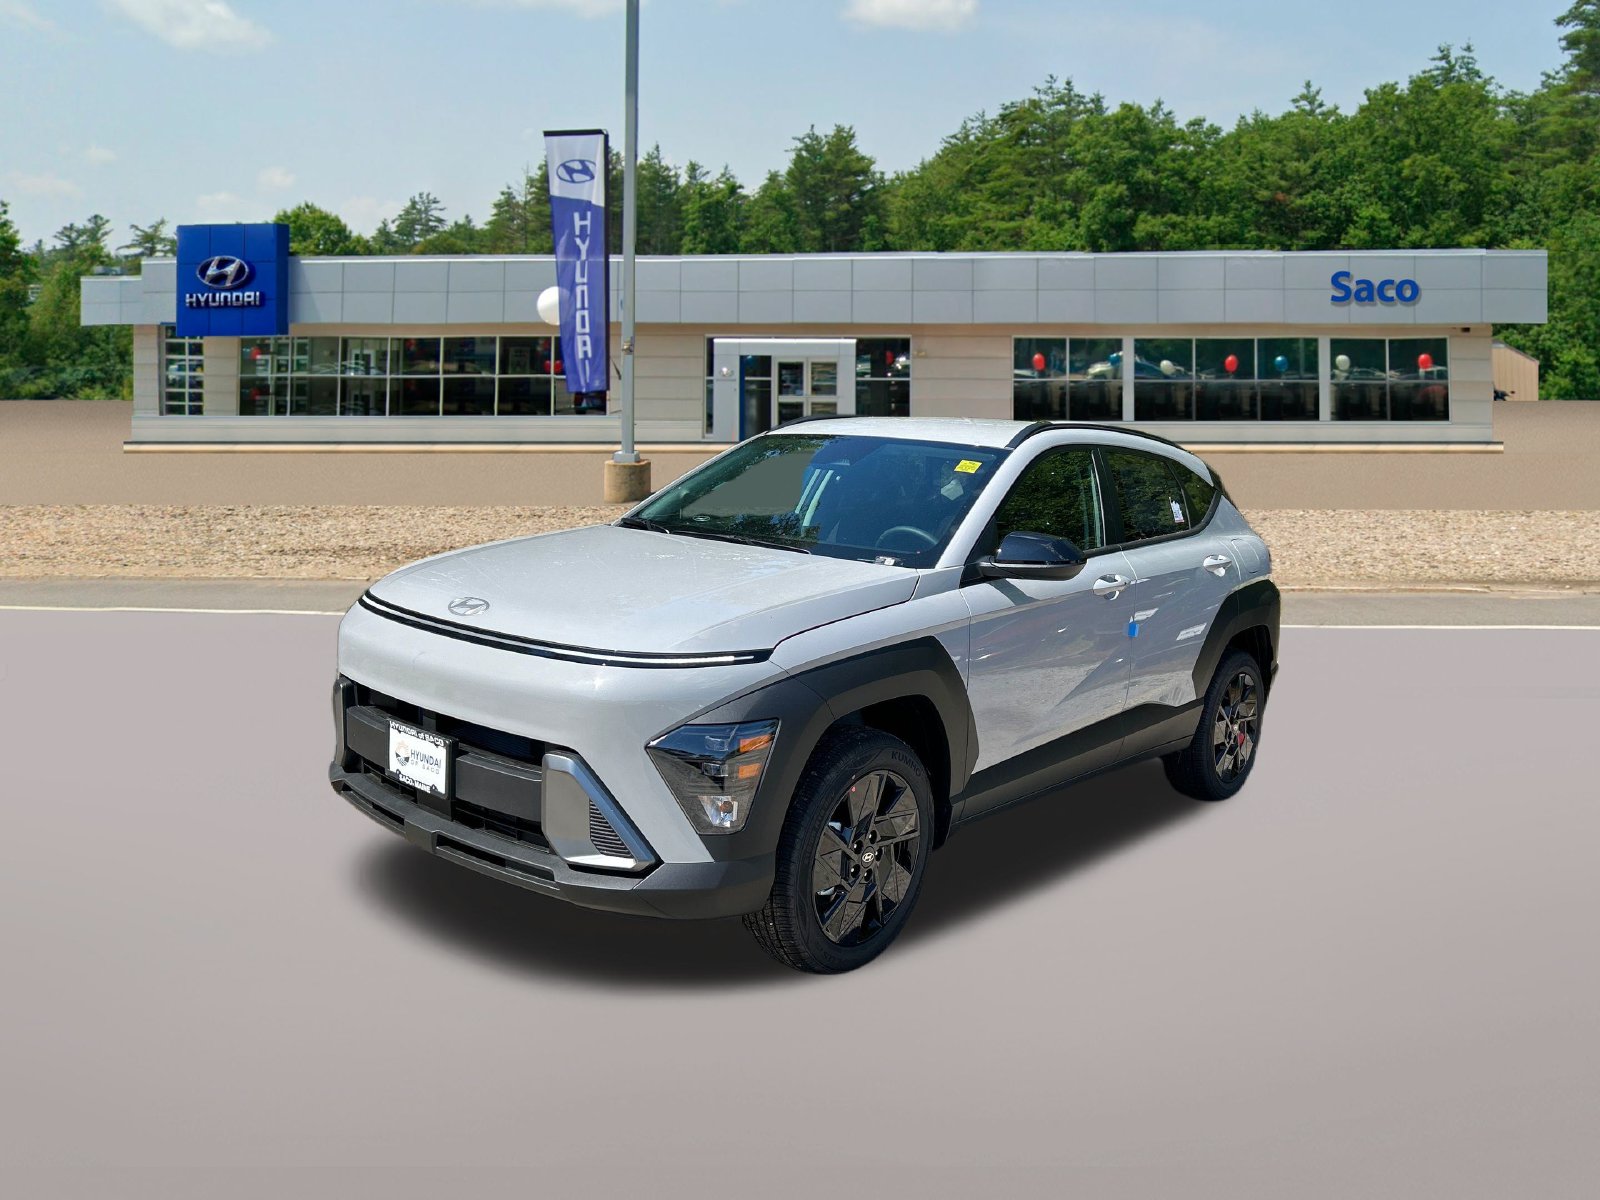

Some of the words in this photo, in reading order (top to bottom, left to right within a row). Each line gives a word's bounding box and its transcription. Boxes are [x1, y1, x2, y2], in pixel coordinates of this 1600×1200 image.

[185, 291, 260, 307] HYUNDAI
[573, 211, 592, 383] HYUNDAI
[1330, 270, 1420, 303] Saco
[410, 748, 442, 769] HYUNDAI
[891, 750, 922, 777] KUMHO
